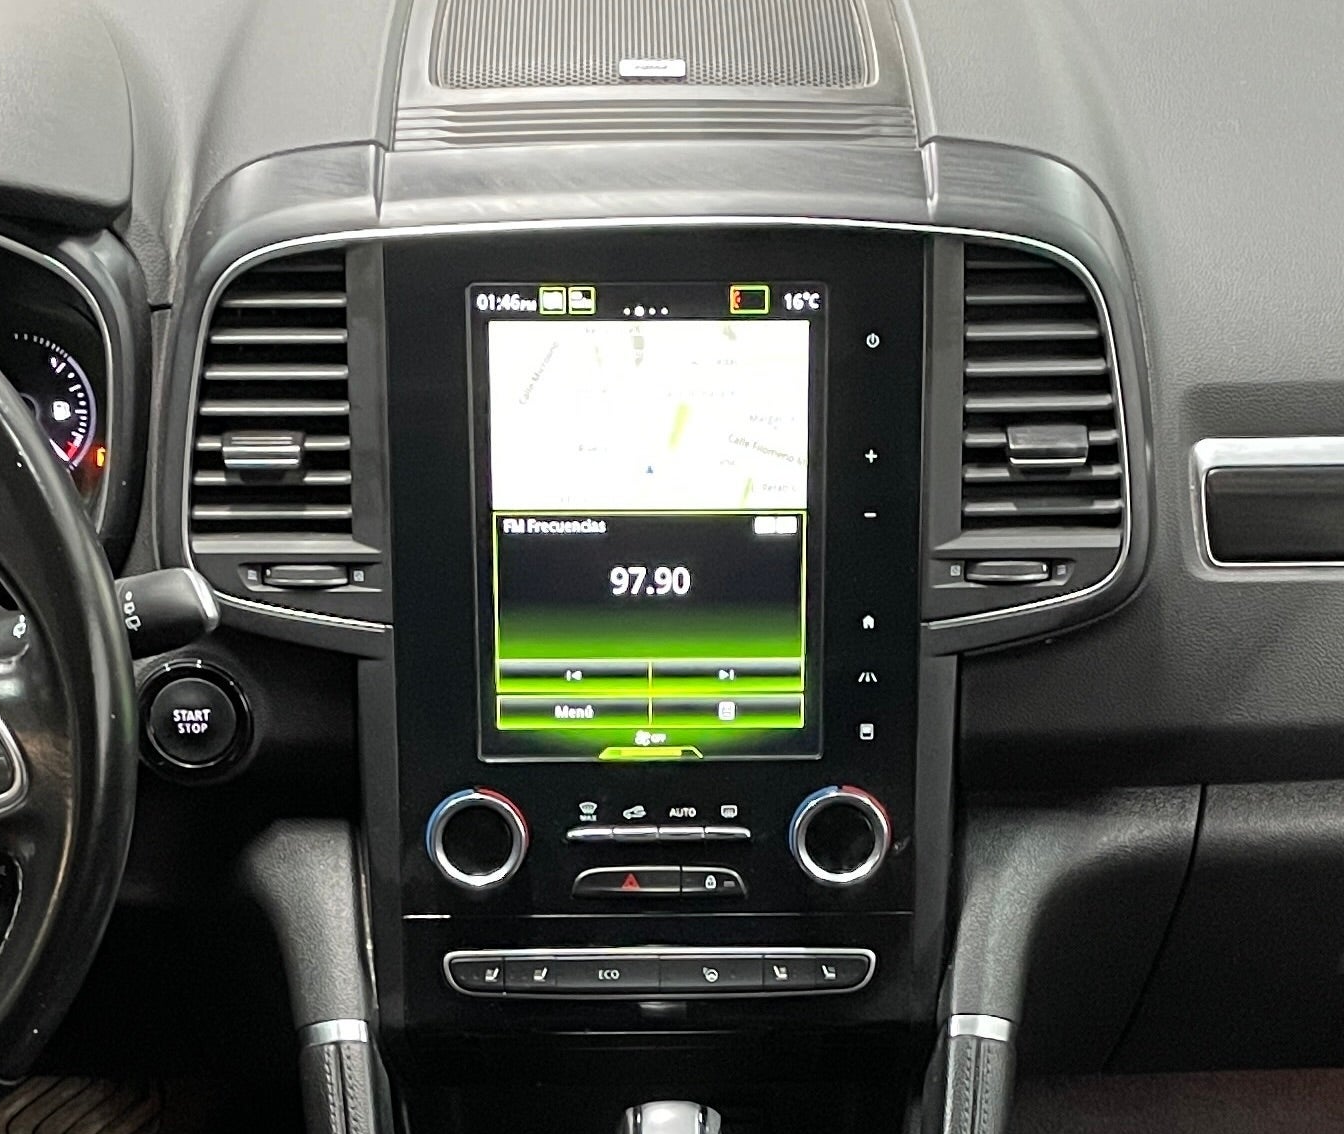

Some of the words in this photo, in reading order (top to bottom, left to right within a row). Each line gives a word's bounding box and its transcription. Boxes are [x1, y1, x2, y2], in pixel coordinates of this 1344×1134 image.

[527, 518, 607, 534] Frecuencias
[610, 566, 691, 595] 97.90
[173, 708, 211, 722] START
[177, 722, 208, 734] STOP
[669, 807, 697, 818] AUTO
[598, 969, 620, 980] ECO
